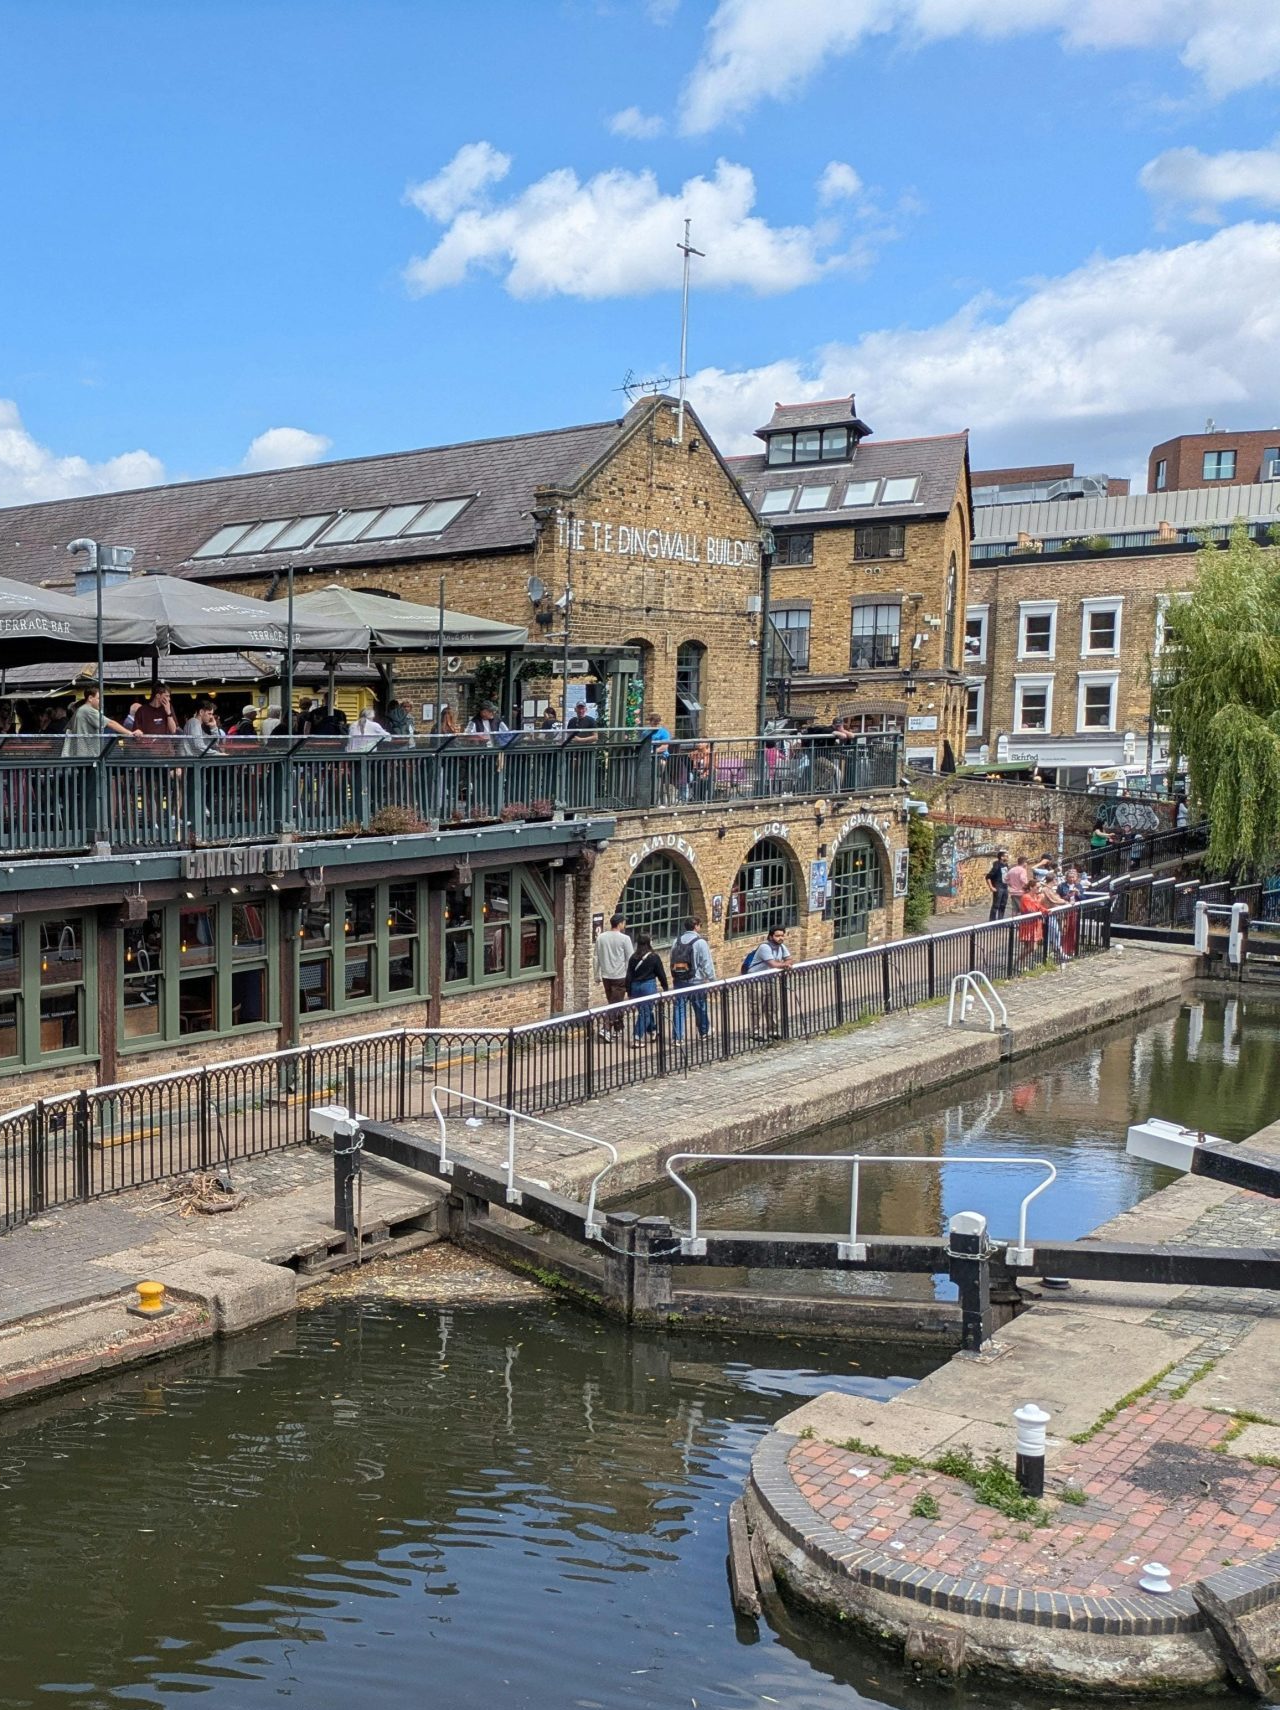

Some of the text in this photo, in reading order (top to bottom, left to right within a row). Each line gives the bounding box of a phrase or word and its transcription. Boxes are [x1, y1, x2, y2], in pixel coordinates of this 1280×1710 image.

[556, 517, 585, 551] THE
[618, 525, 700, 562] DINGWALL
[706, 536, 760, 567] BUILDING
[50, 620, 70, 633] BAR
[248, 630, 301, 643] TERRACE BR
[753, 822, 790, 842] LOCK
[832, 813, 891, 854] DINGWALLS
[186, 846, 299, 879] CANALSIDE BAR
[629, 834, 696, 867] CAMDEN
